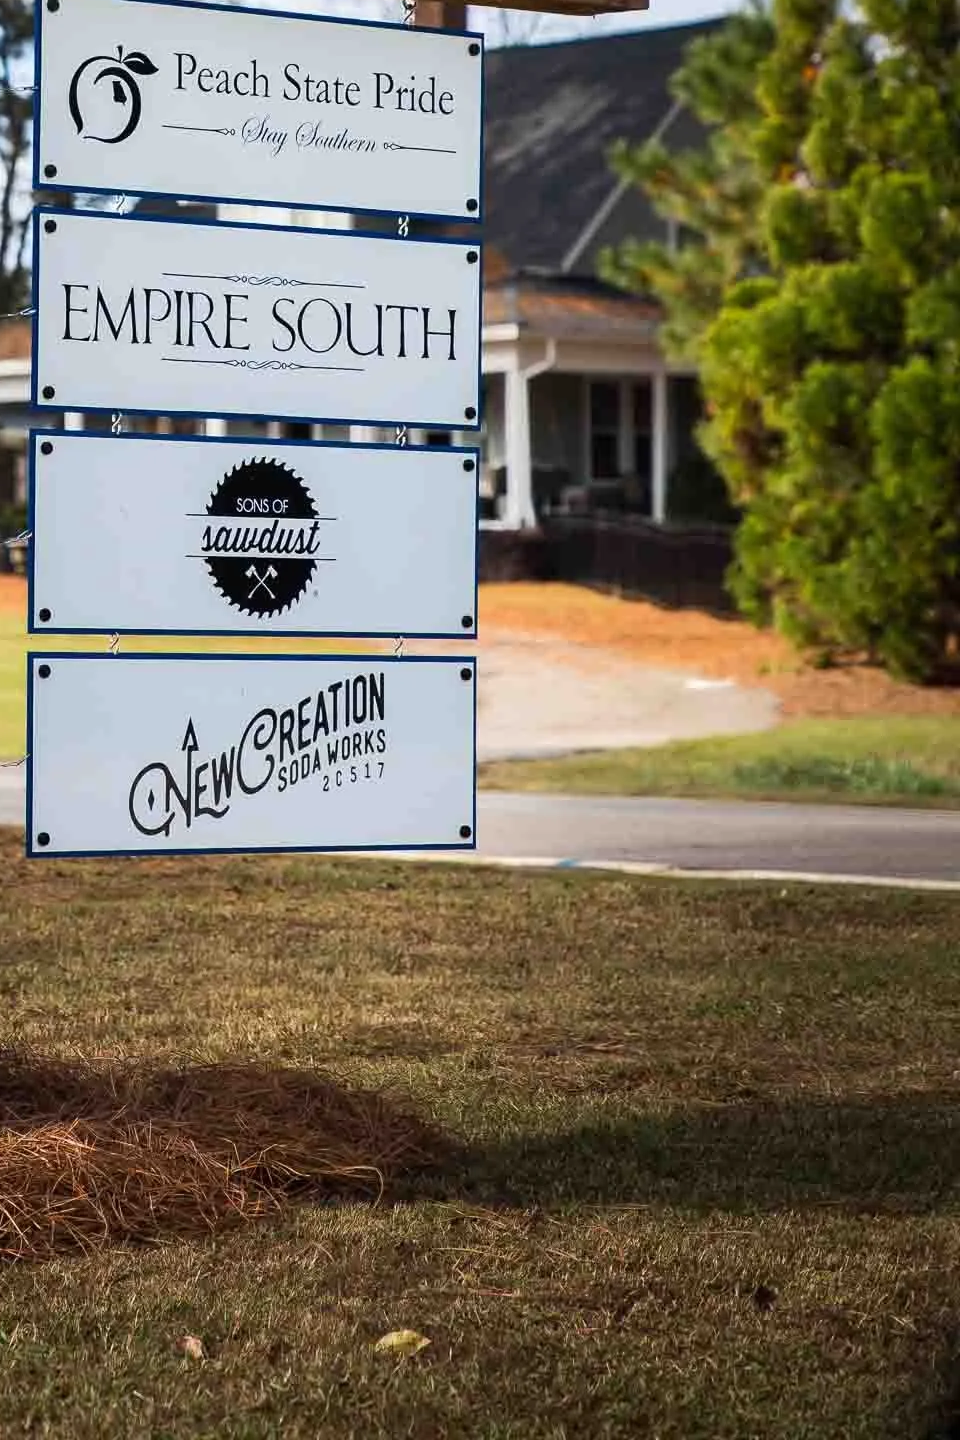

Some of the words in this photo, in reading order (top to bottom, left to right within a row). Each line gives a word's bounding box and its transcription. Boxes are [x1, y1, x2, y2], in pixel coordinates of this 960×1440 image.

[174, 53, 270, 98] Peach
[283, 63, 361, 106] State
[372, 72, 455, 115] Pride
[241, 113, 289, 157] Stay
[295, 120, 377, 153] Southern
[62, 283, 250, 351] EMPIRE
[271, 297, 457, 361] SOUTH
[236, 498, 270, 513] SONS
[272, 498, 289, 513] OF
[201, 519, 321, 555] sawdust
[278, 748, 321, 792] SODA
[327, 728, 386, 767] WORKS
